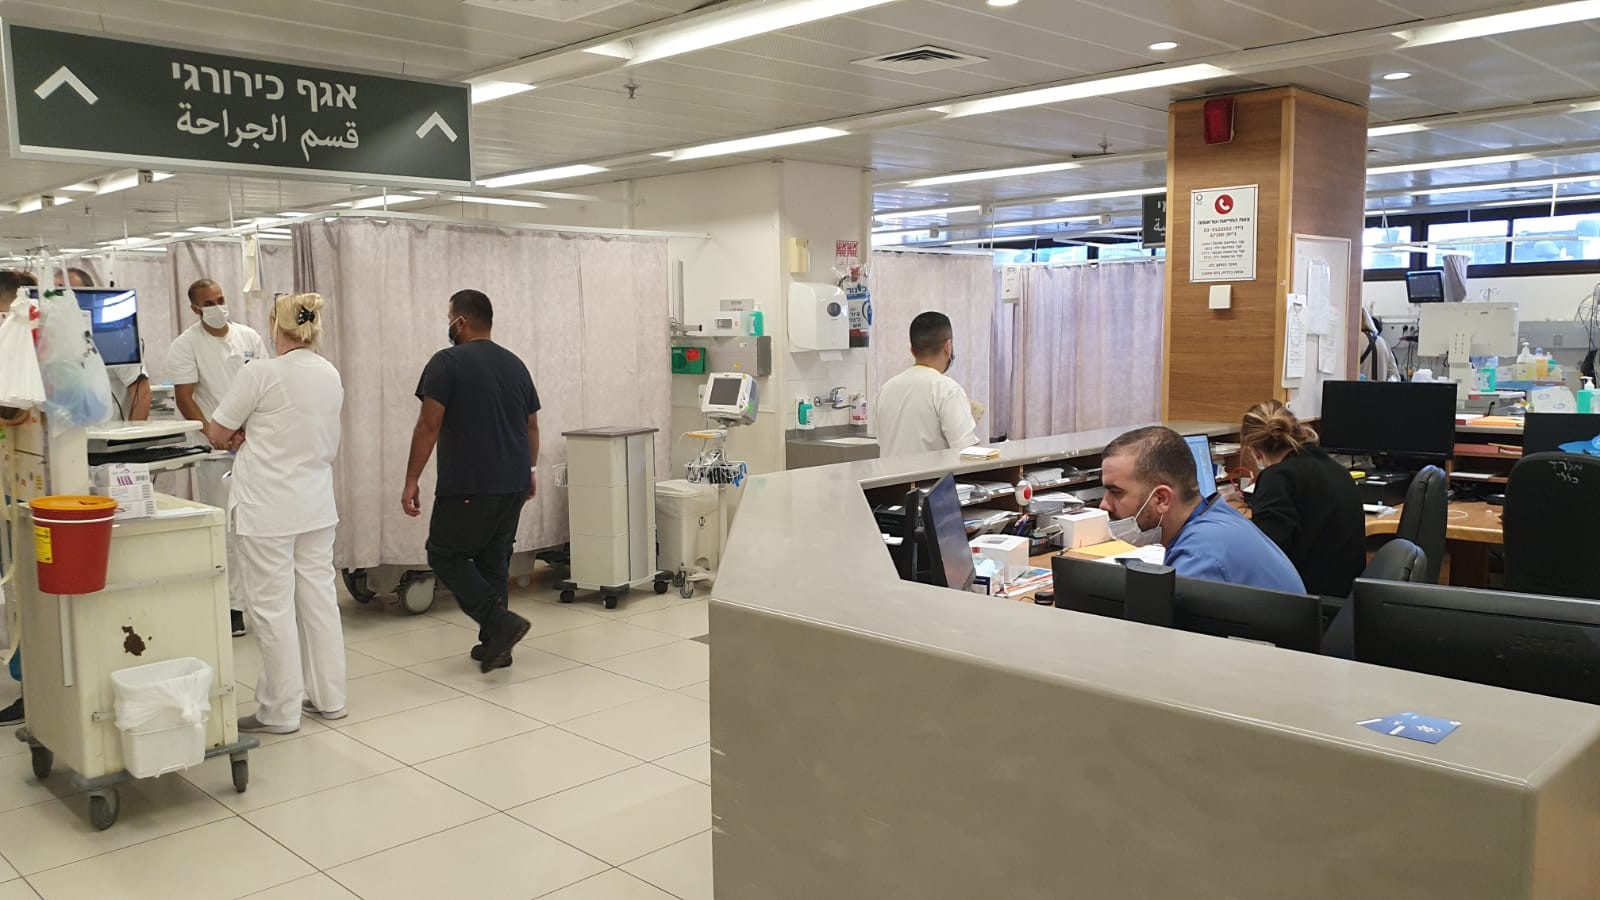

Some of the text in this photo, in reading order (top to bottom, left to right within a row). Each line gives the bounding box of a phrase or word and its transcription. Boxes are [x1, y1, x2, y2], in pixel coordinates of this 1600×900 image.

[170, 61, 358, 112] אגף כירורגי
[175, 102, 360, 162] قسم الجراحة
